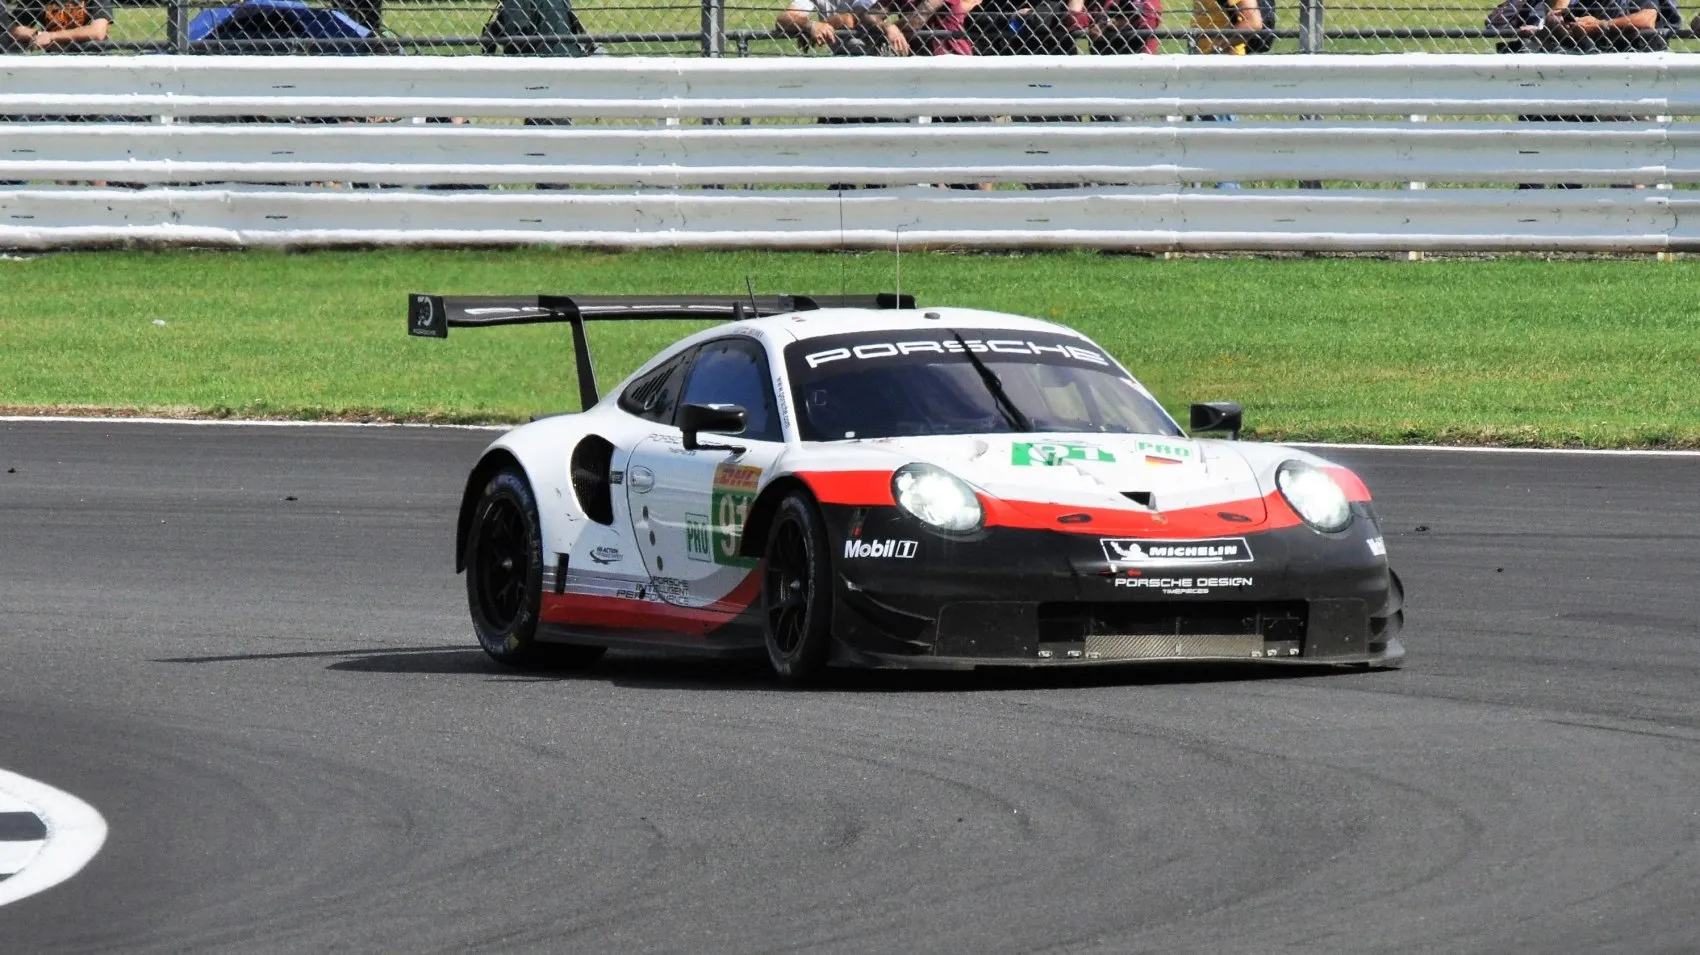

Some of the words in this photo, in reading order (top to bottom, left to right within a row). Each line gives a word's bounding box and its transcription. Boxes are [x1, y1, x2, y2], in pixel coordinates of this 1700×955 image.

[805, 340, 1109, 368] PORSCHE
[1138, 441, 1191, 458] PRO
[719, 493, 750, 557] 91
[686, 520, 710, 555] PRO
[844, 539, 896, 558] Mobil
[1149, 546, 1238, 557] MICHELIN
[652, 576, 689, 587] PORSCHE
[1114, 578, 1193, 587] PORSCHE
[1197, 577, 1253, 586] DESIGN
